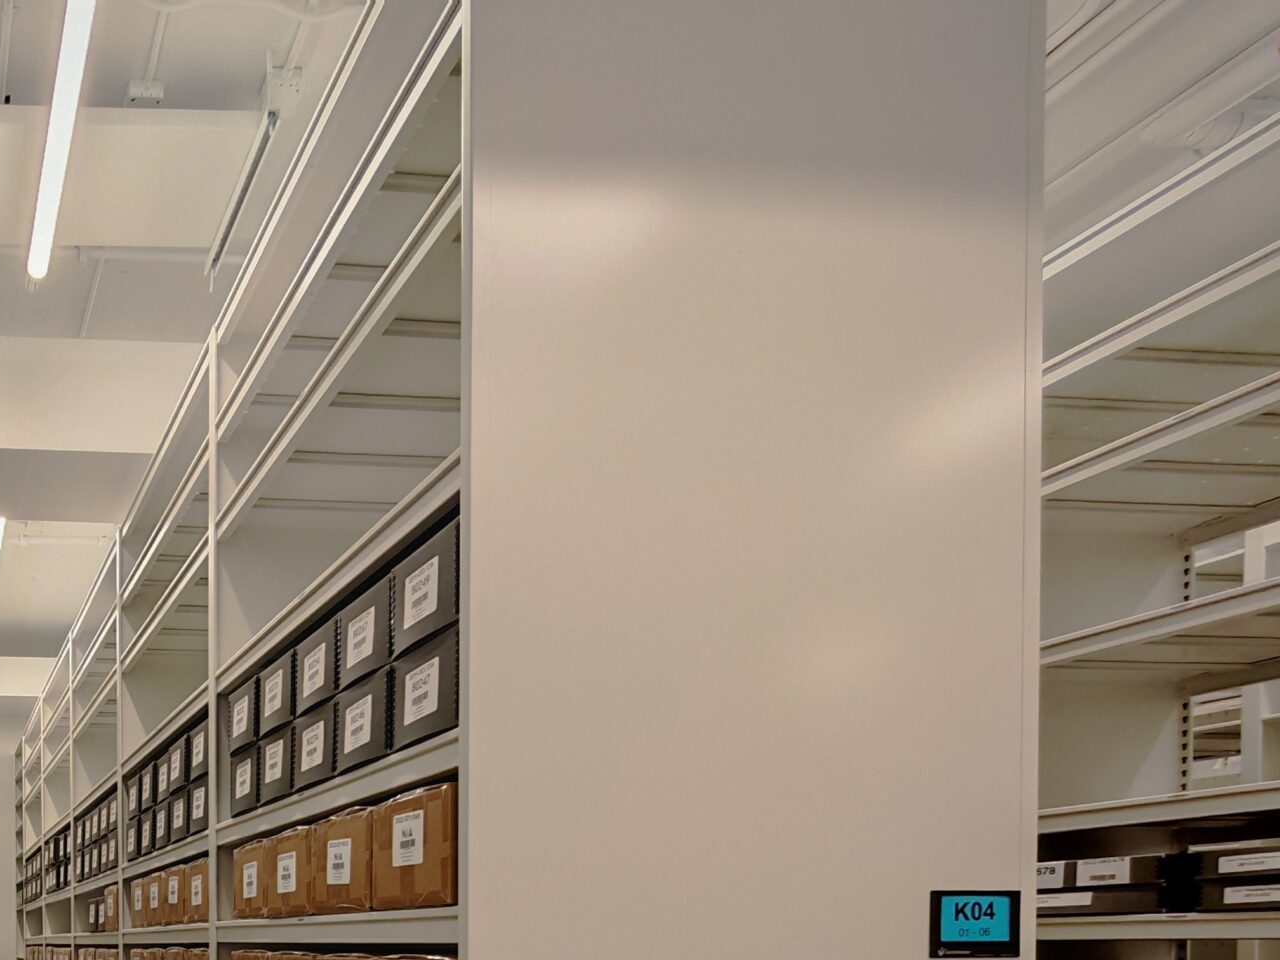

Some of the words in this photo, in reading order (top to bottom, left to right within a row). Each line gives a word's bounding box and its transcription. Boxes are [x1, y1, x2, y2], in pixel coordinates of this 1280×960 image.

[402, 827, 413, 838] N/A
[954, 902, 995, 921] K04
[959, 928, 969, 937] 01
